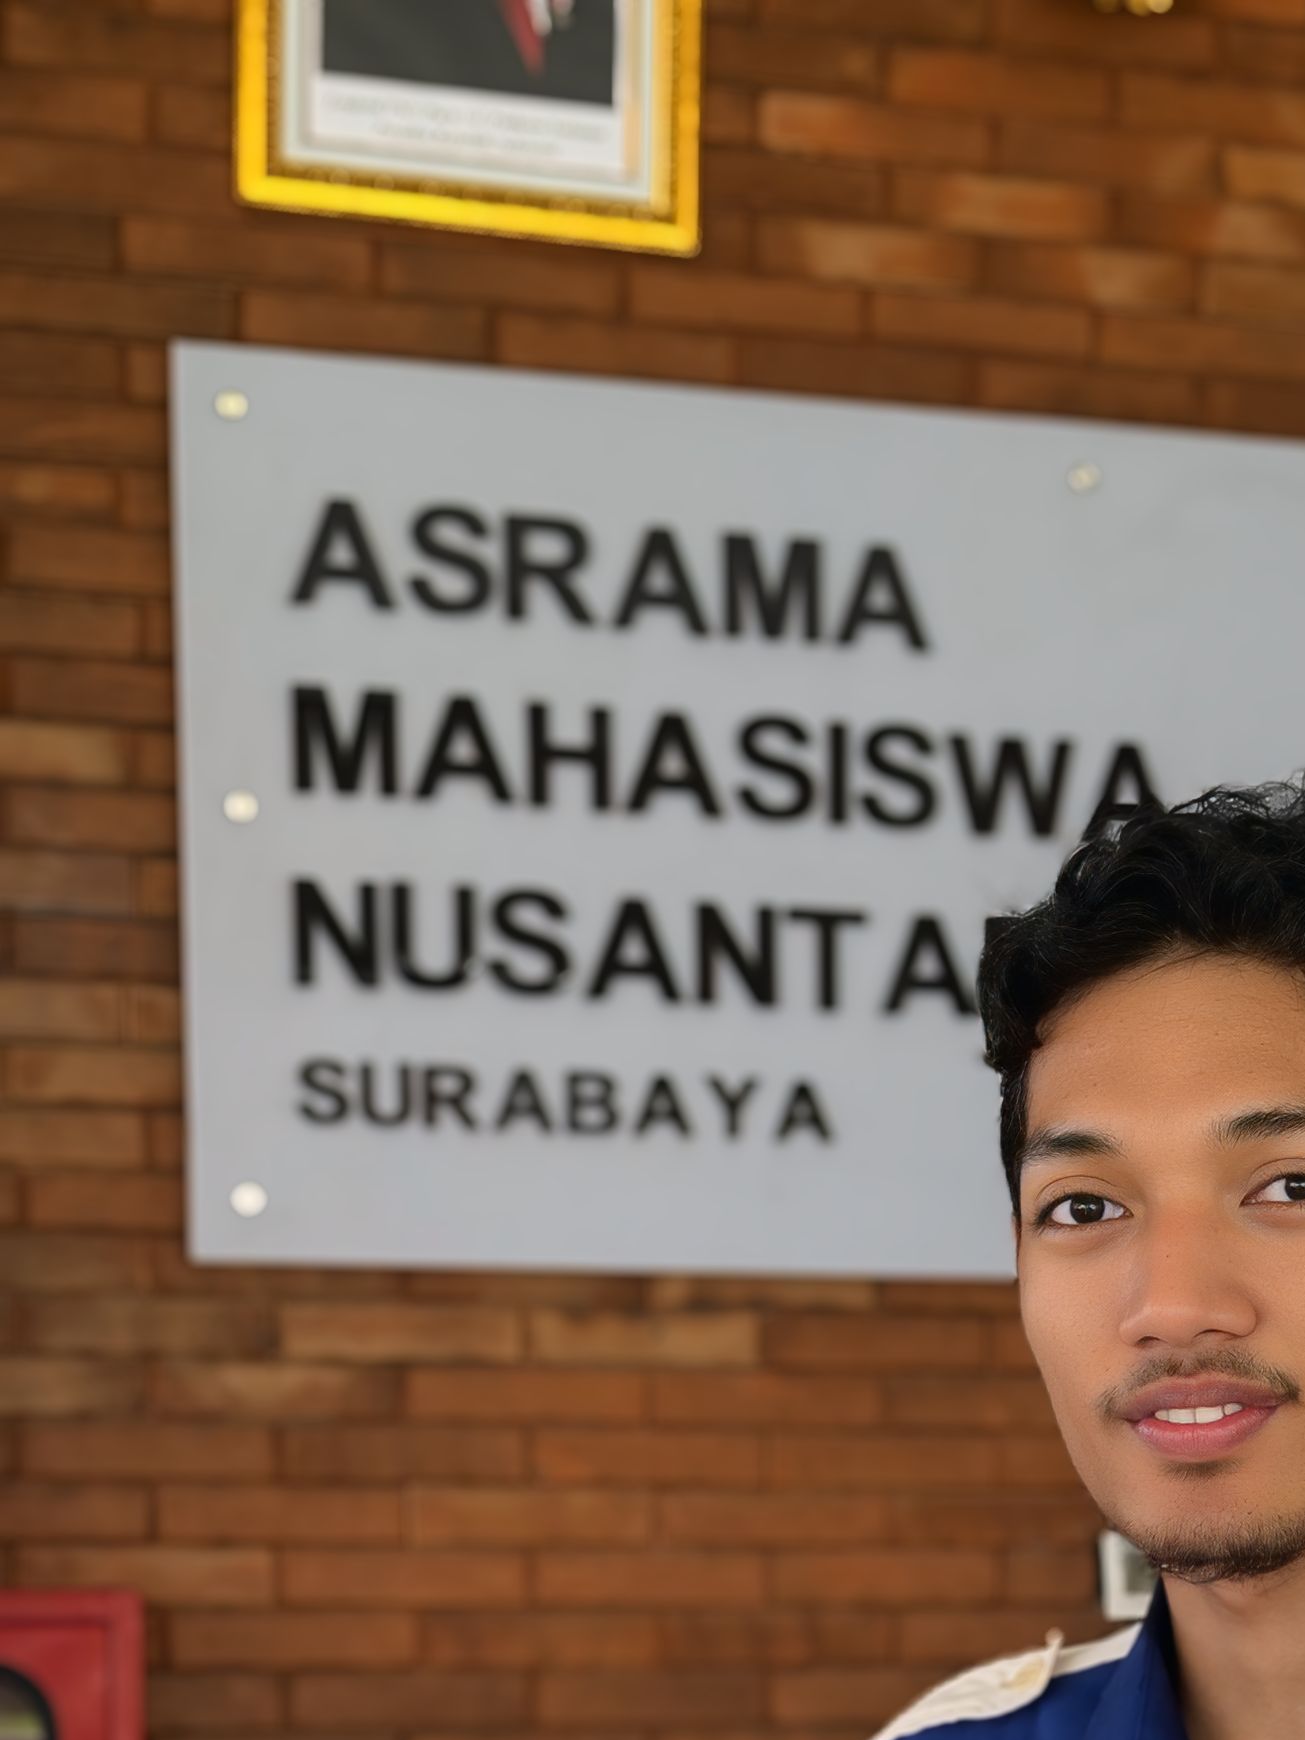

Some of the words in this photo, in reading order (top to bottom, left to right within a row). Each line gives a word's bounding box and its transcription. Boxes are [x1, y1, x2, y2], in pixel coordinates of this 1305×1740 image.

[291, 497, 930, 653] ASRAMA
[290, 685, 1166, 842] MAHASISWA
[291, 879, 1000, 1017] NUSANTA
[296, 1055, 835, 1142] SURABAYA
